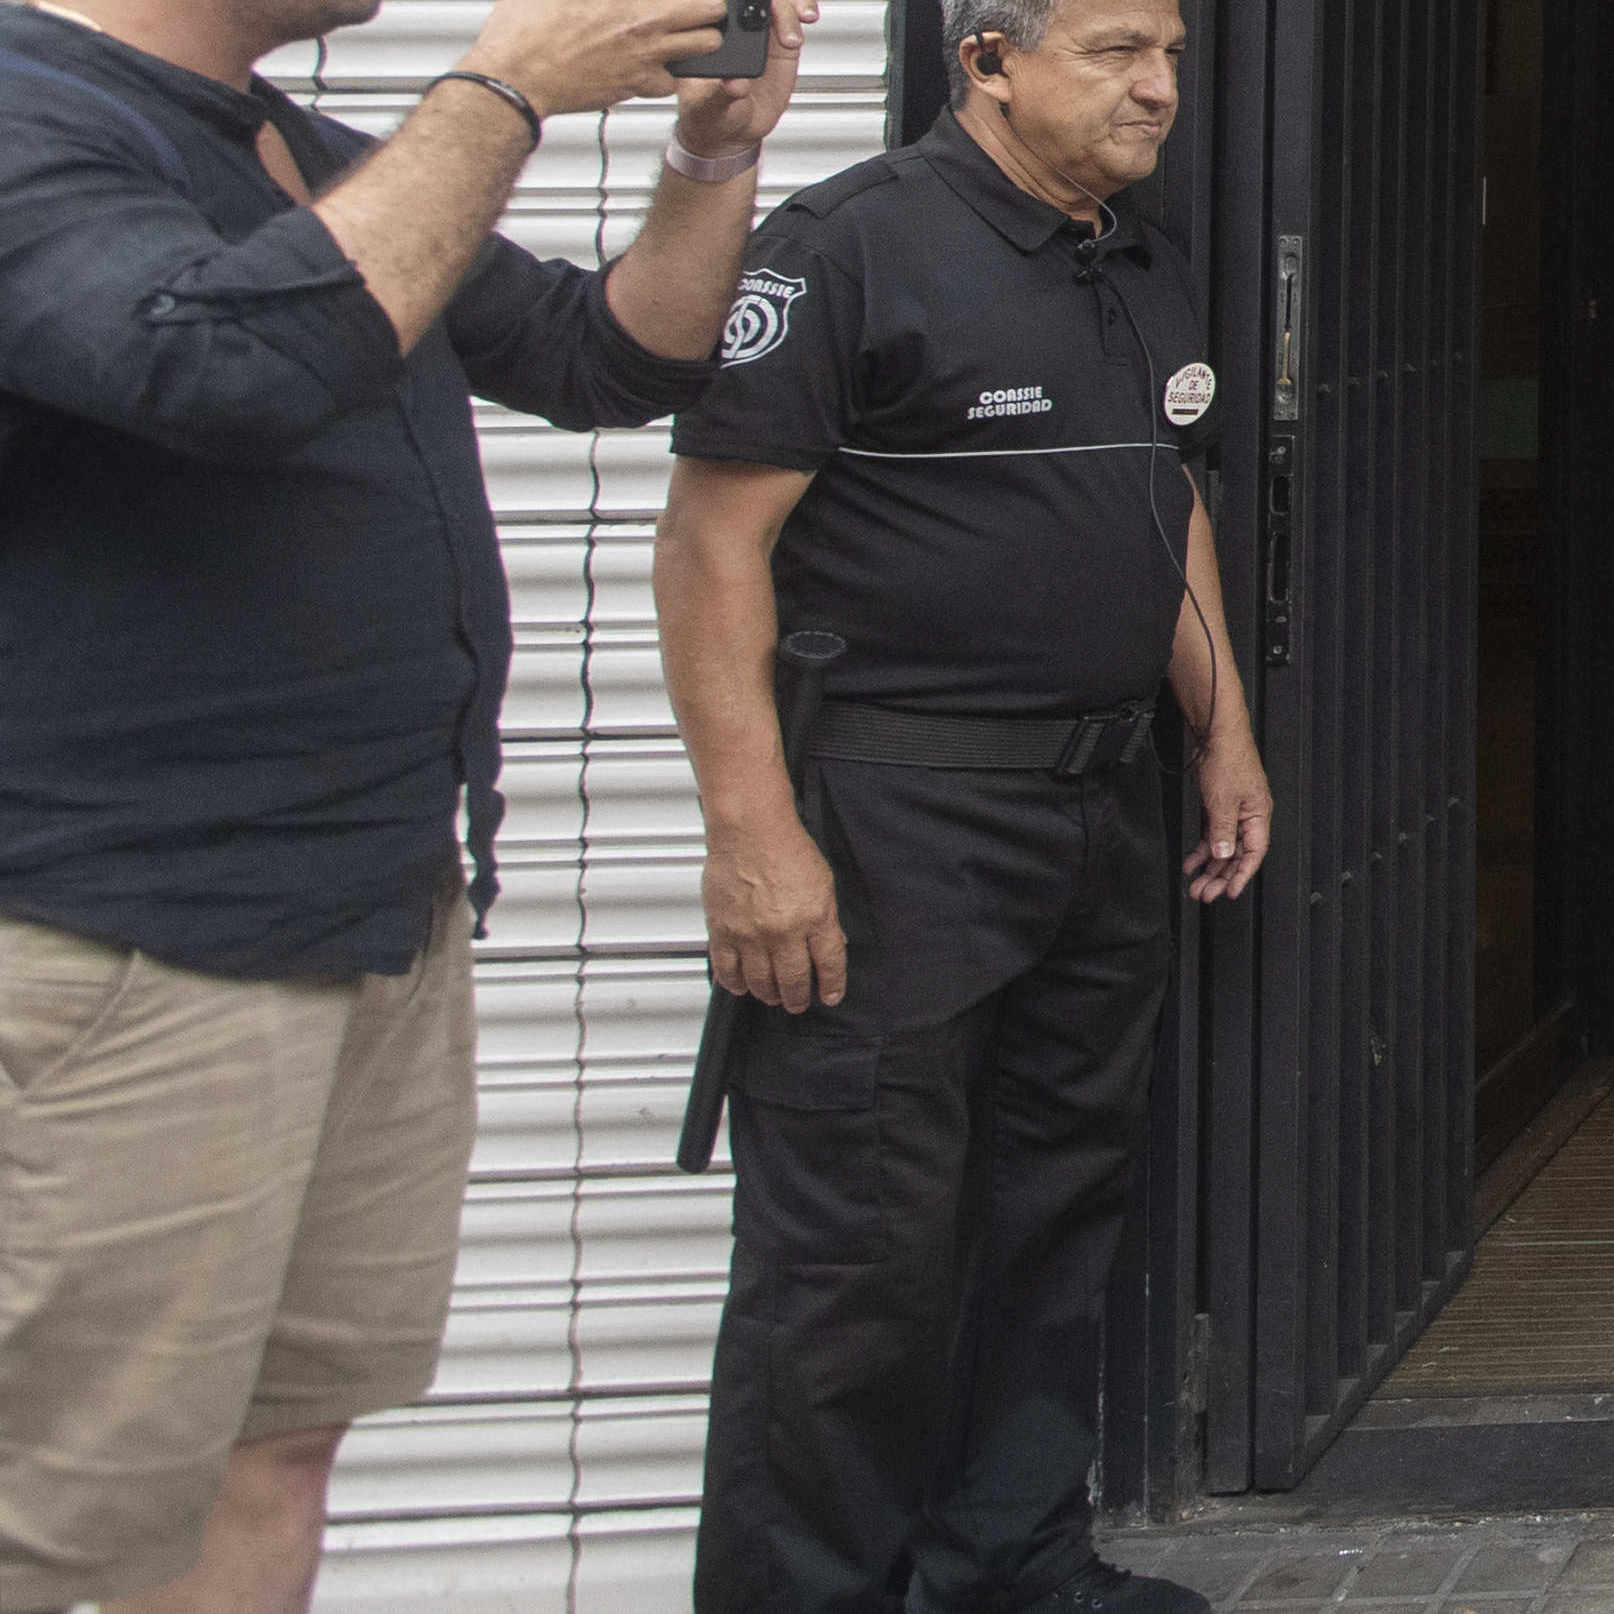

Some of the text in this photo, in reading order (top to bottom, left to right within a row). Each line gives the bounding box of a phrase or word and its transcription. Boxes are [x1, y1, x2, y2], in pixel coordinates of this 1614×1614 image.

[1174, 367, 1213, 391] VIGILANTE
[1187, 379, 1199, 391] DE
[979, 386, 1043, 405] COASSIE
[1167, 391, 1212, 404] SEGURIDAD
[967, 399, 1053, 420] SEGURIDAD
